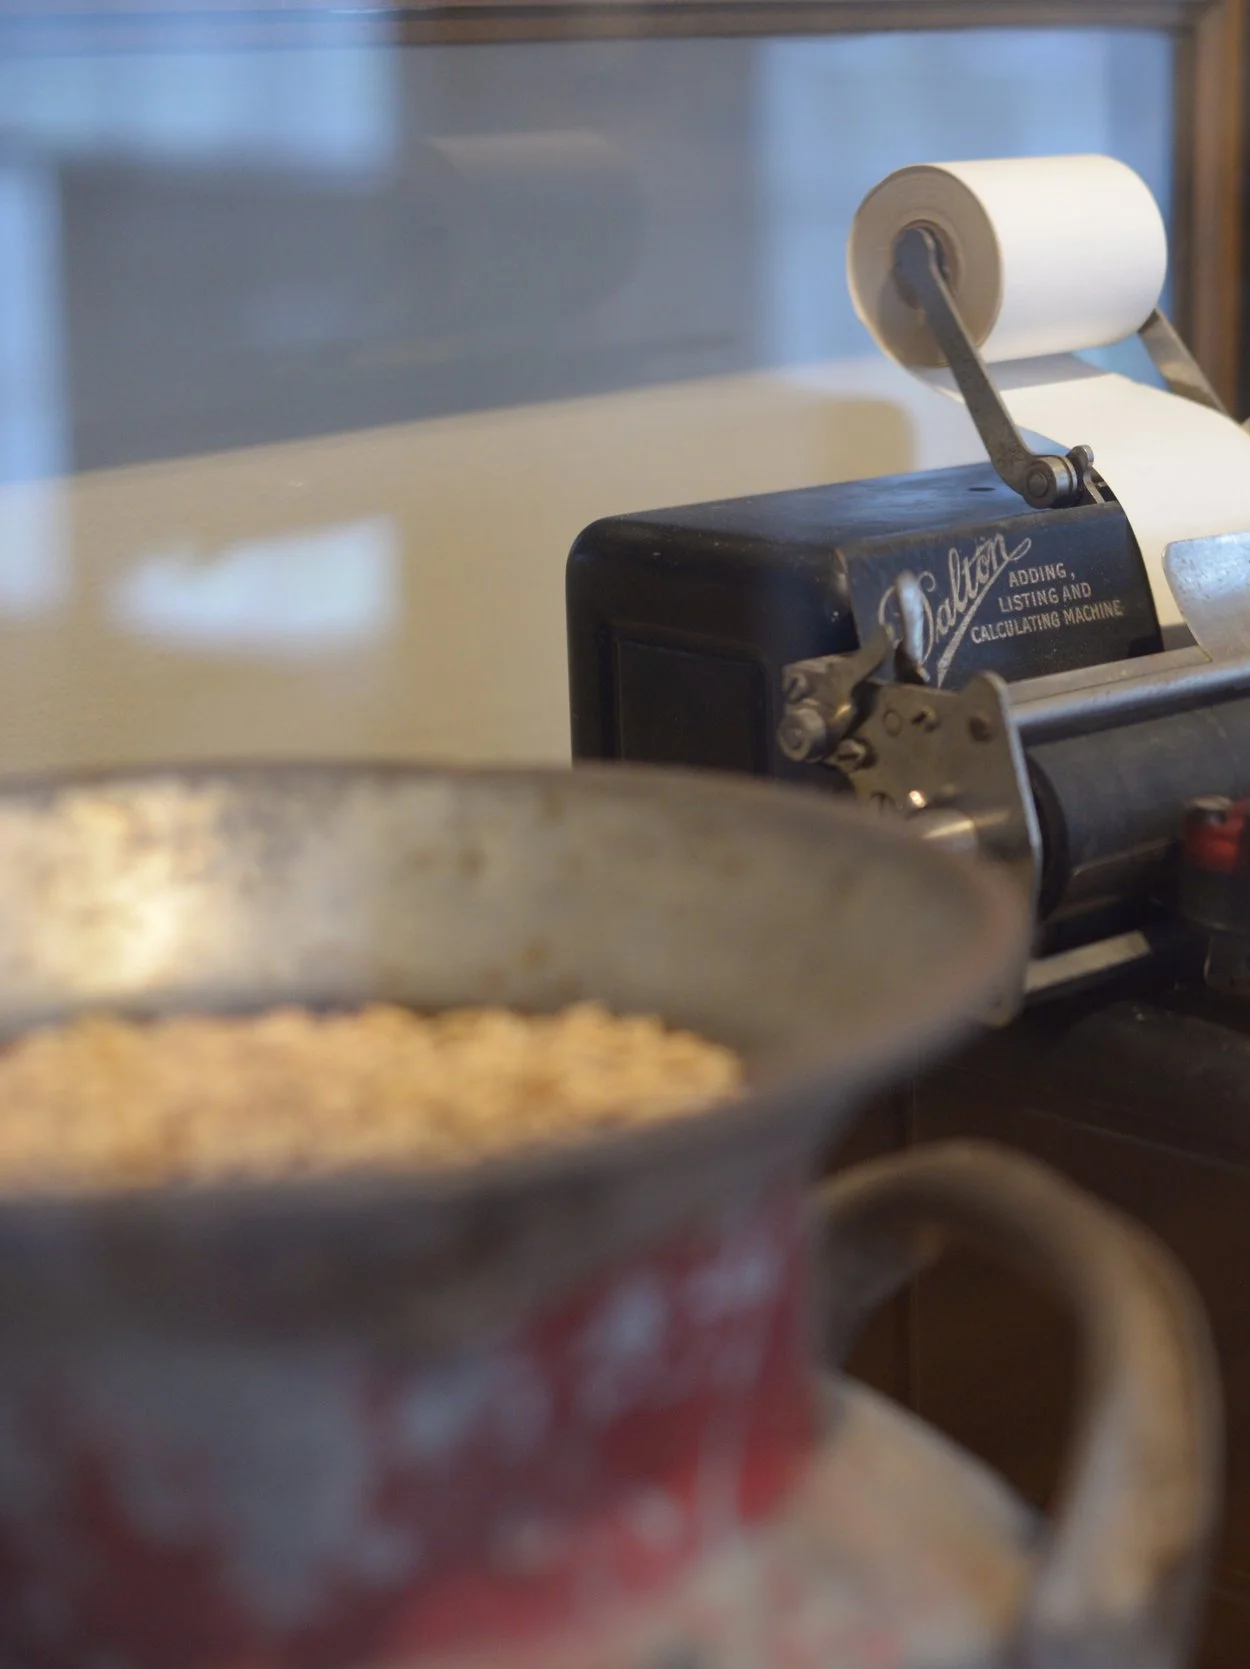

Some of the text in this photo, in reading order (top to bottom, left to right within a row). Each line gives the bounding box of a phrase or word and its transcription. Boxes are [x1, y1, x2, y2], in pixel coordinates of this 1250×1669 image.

[998, 582, 1092, 613] LISTING AND
[970, 599, 1124, 644] CALCULATING MACHINE
